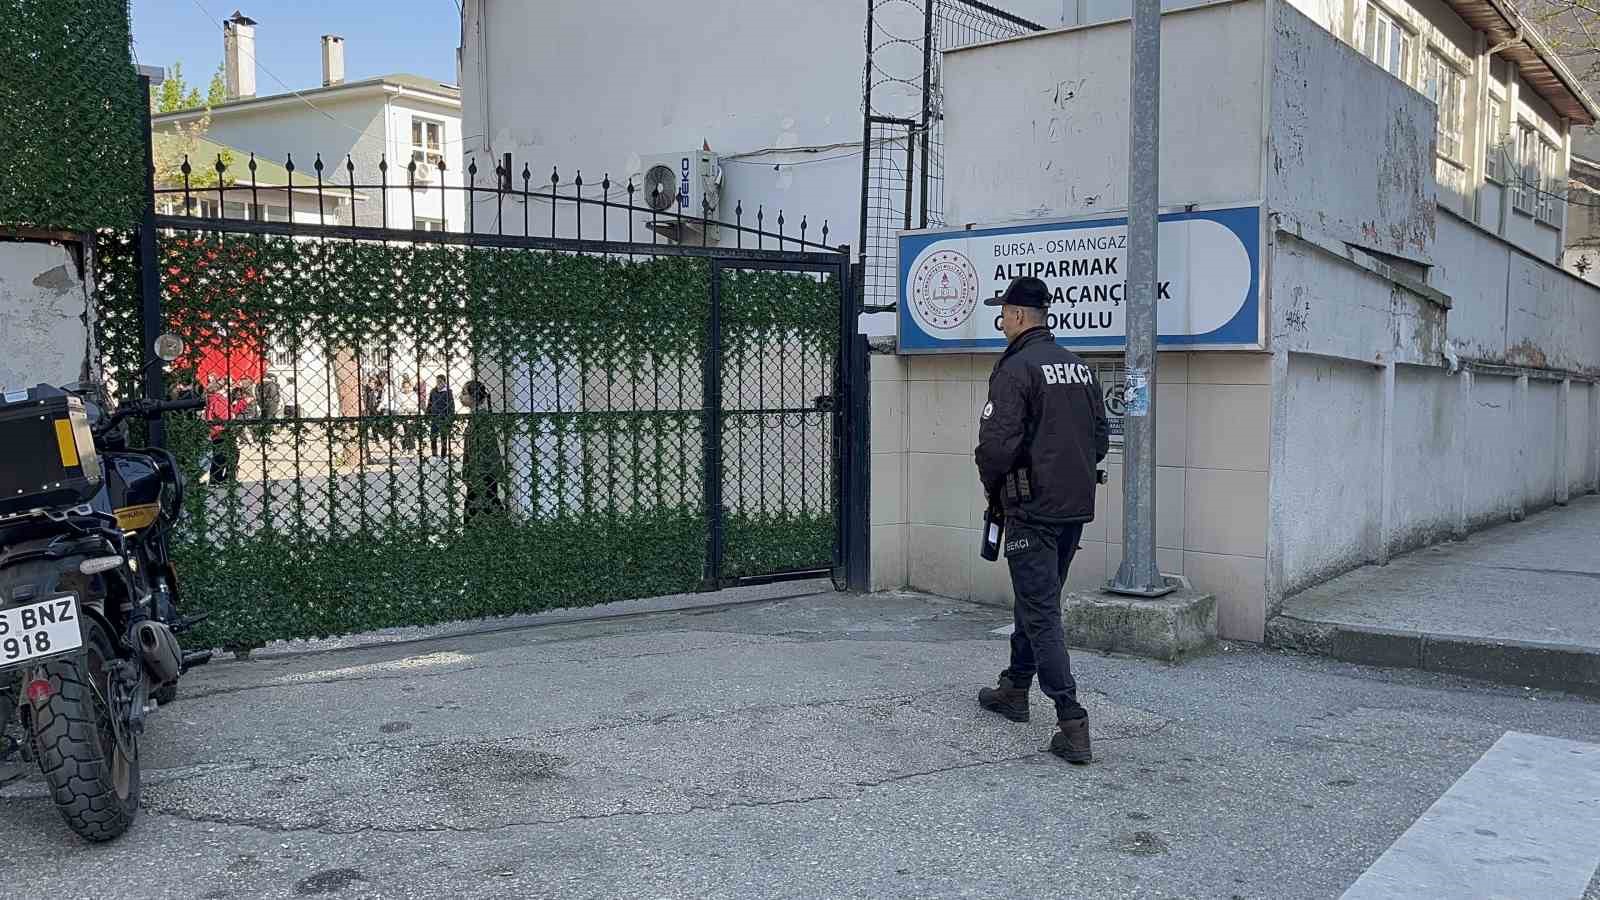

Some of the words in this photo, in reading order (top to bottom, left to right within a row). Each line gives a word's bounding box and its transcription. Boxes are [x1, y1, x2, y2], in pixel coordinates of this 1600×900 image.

[681, 157, 689, 209] BEKO
[994, 242, 1035, 257] BURSA
[1046, 235, 1127, 254] OSMANGAZ
[994, 257, 1118, 280] ALTIPARMAK
[1052, 280, 1171, 308] AÇANÇİK
[21, 600, 74, 630] BNZ
[3, 631, 51, 659] 918
